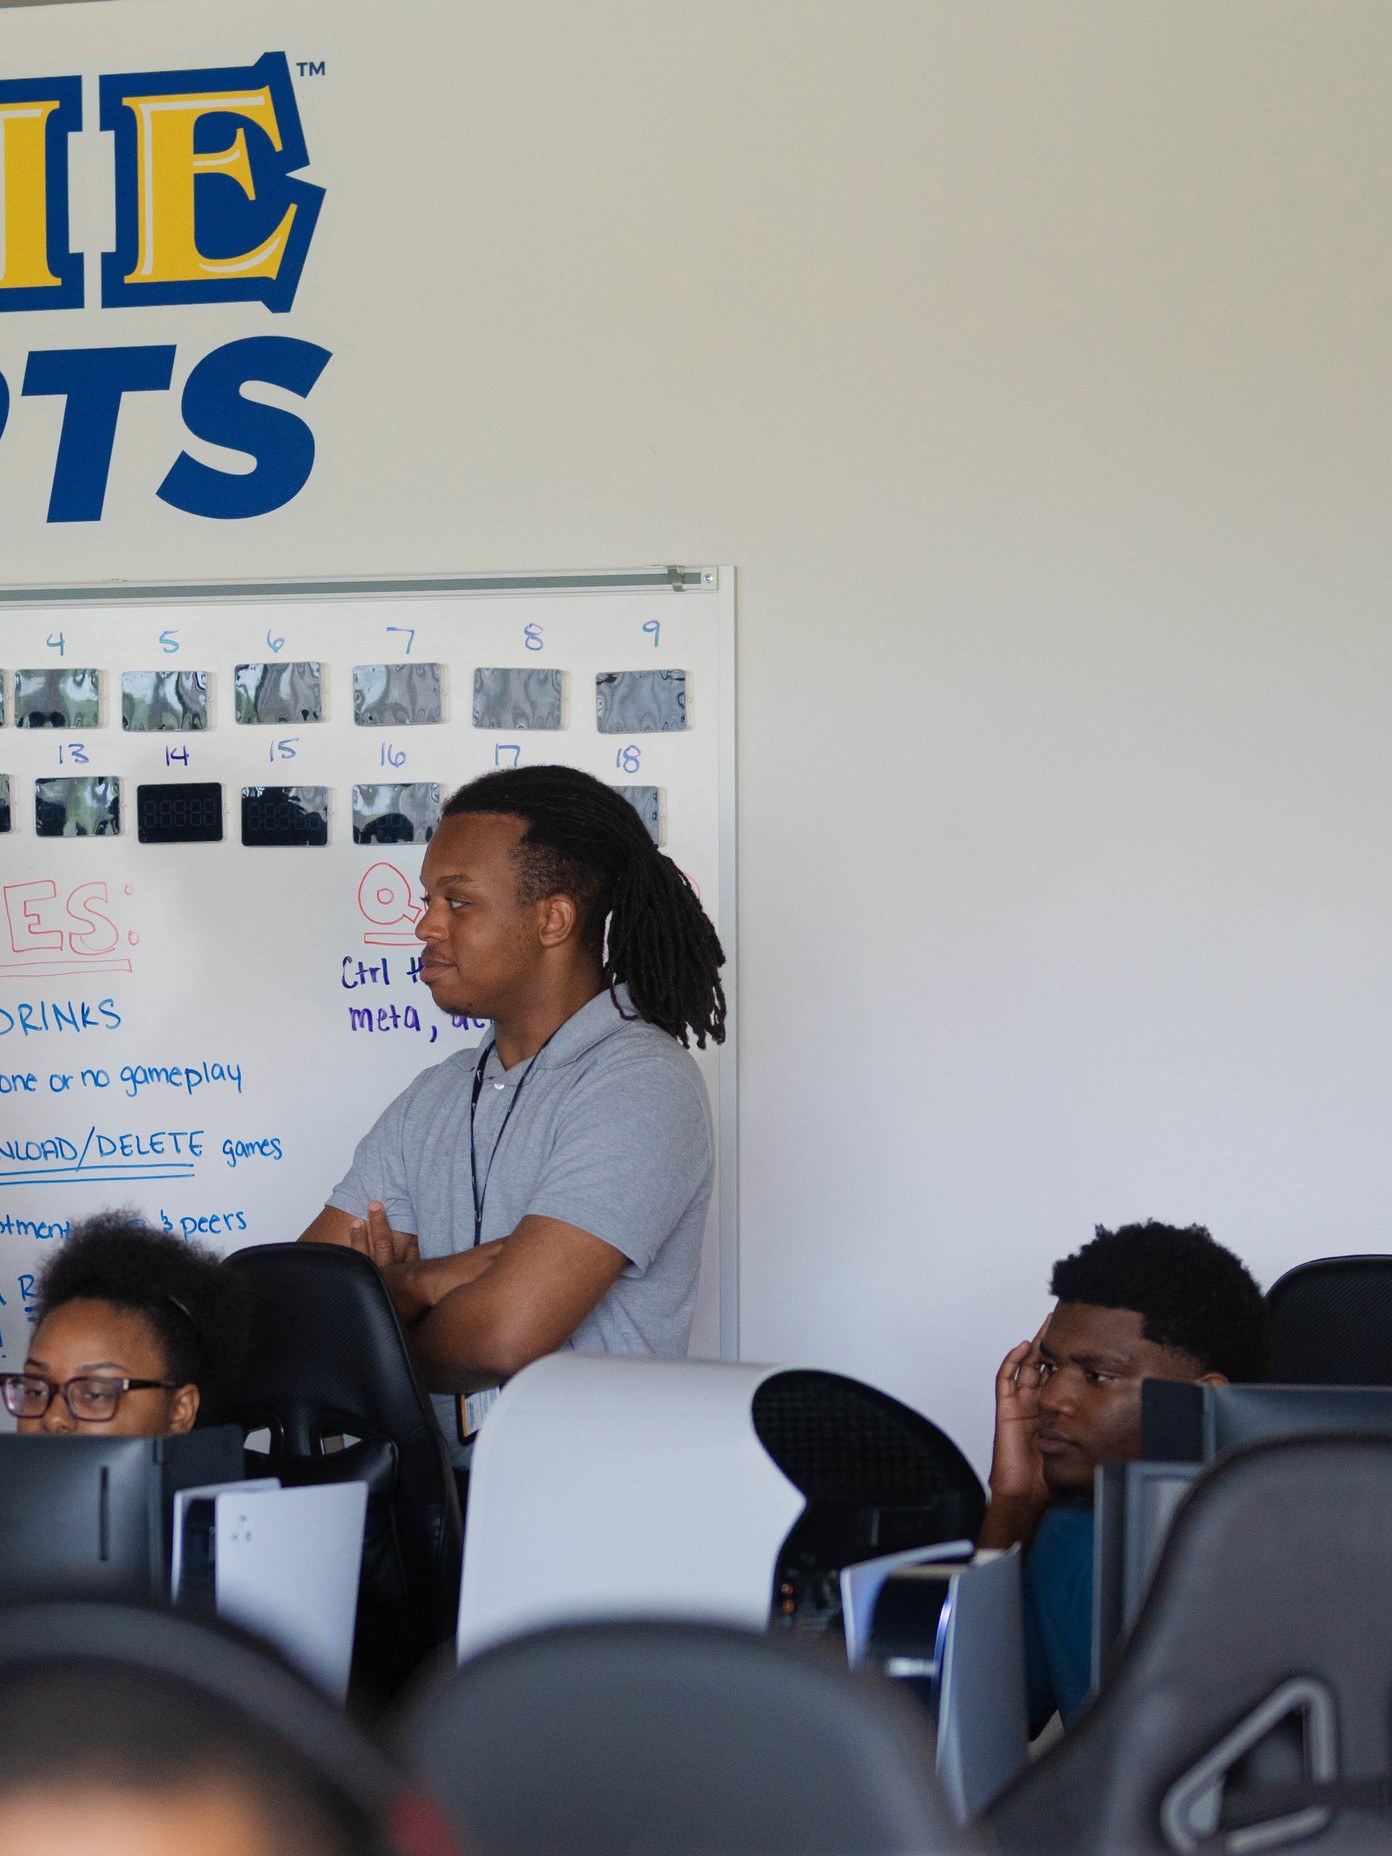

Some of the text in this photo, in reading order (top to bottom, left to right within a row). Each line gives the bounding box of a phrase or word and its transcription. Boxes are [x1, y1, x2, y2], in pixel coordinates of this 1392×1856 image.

[46, 631, 66, 656] 4
[158, 630, 181, 654] 5
[266, 629, 286, 653] 6
[386, 626, 416, 654] 7
[524, 622, 545, 651] 8
[642, 619, 662, 647] 9
[58, 743, 90, 765] 13
[164, 744, 190, 767] 14
[268, 738, 300, 763] 15
[380, 742, 407, 768] 16
[494, 743, 522, 767] 17
[615, 744, 642, 775] 18
[341, 955, 391, 990] Ctrl
[349, 1004, 439, 1044] meta,
[49, 1074, 72, 1091] or
[81, 1070, 110, 1088] no
[120, 1061, 243, 1097] gameplay
[222, 1137, 284, 1167] games
[180, 1210, 248, 1240] peers
